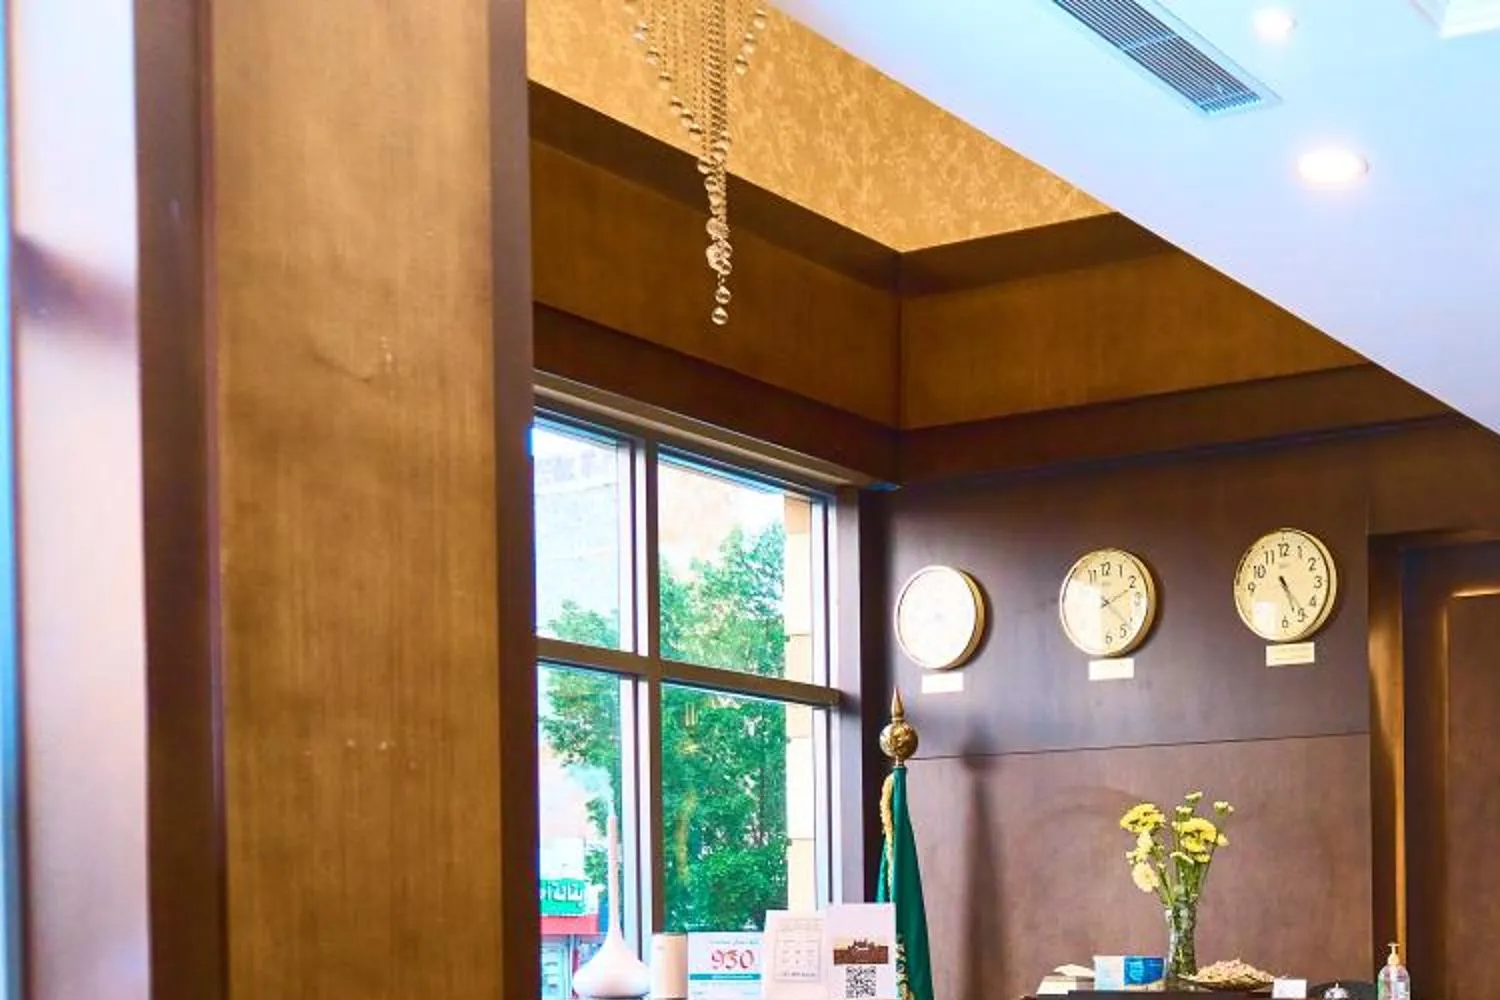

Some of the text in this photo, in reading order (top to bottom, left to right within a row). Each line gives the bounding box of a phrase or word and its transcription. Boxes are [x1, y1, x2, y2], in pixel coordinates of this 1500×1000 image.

[1264, 549, 1275, 565] 11
[1277, 543, 1290, 557] 12
[1100, 561, 1111, 577] 12
[1307, 557, 1317, 571] 2
[1088, 569, 1097, 585] 11
[1253, 565, 1266, 579] 10
[1128, 575, 1137, 589] 2
[1313, 575, 1323, 589] 3
[1247, 582, 1256, 597] 9
[1309, 595, 1317, 607] 4
[1281, 615, 1289, 629] 6
[1297, 608, 1306, 622] 5
[1119, 623, 1127, 638] 5
[1105, 633, 1113, 645] 6
[711, 949, 755, 970] 930
